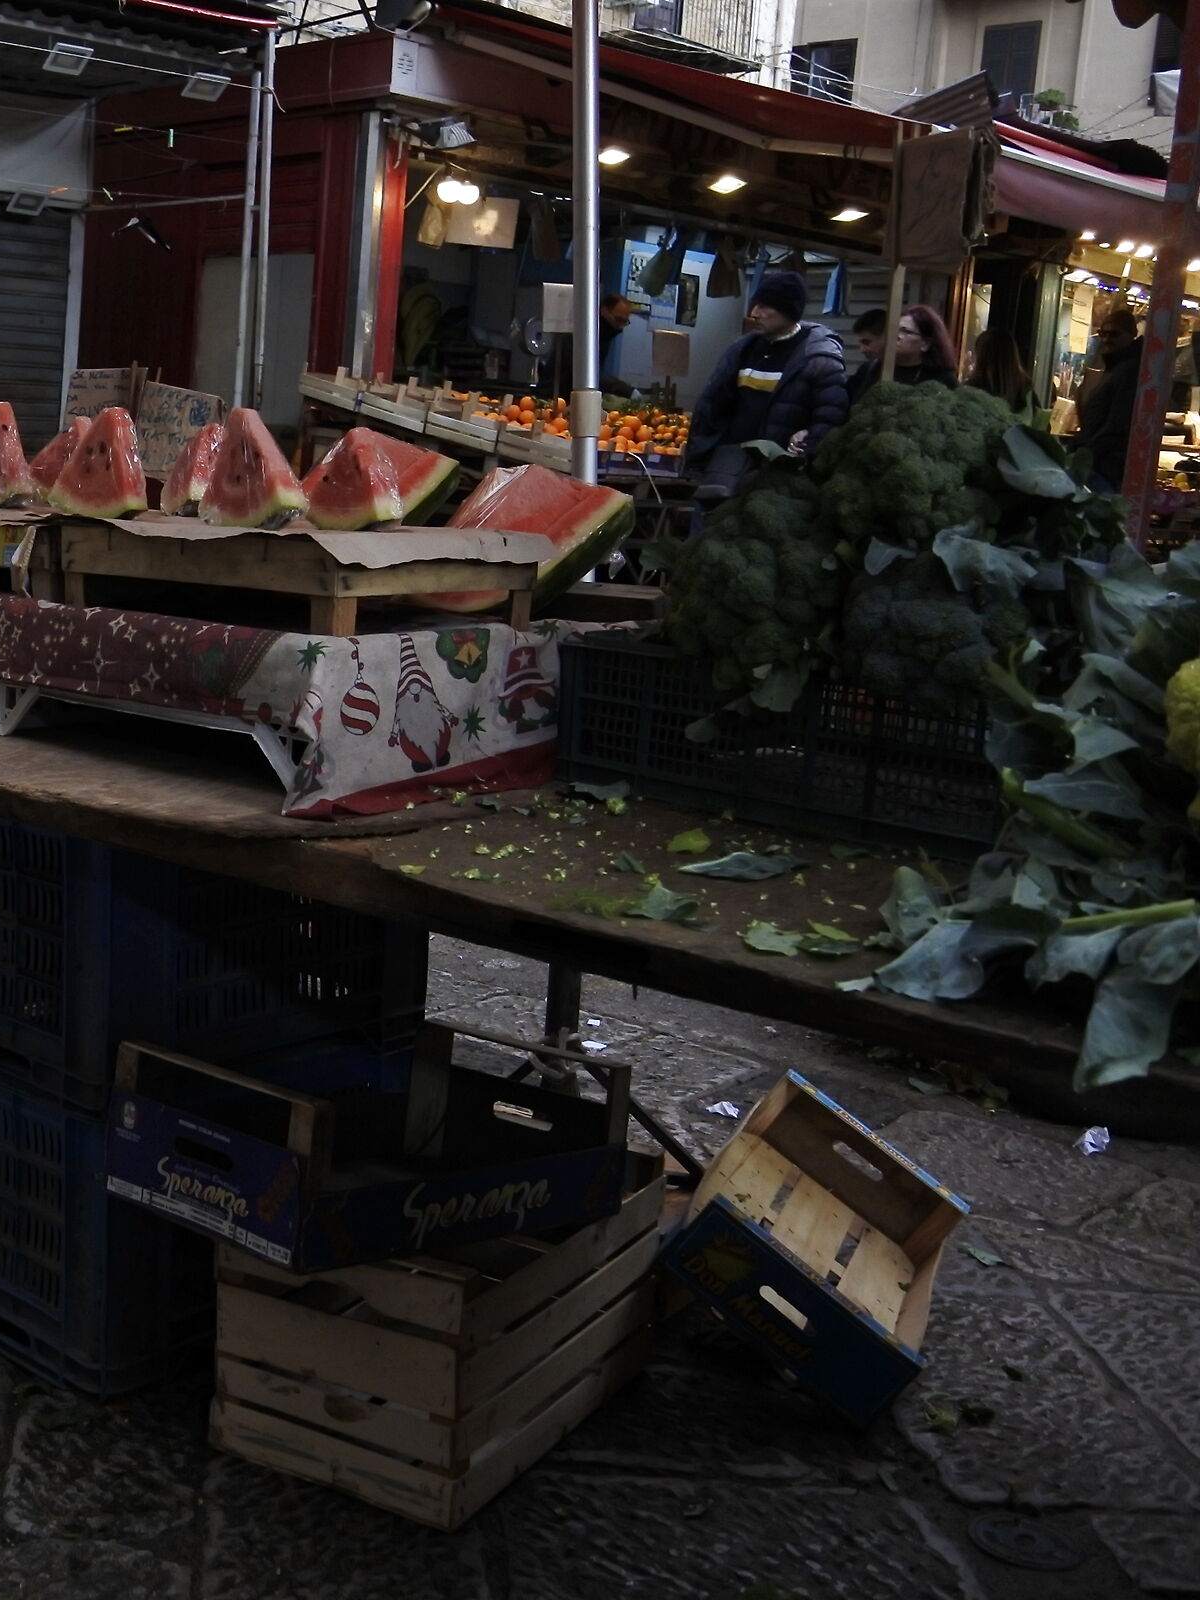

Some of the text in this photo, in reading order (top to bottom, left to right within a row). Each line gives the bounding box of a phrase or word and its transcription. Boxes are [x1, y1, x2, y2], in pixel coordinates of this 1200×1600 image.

[156, 1155, 249, 1225] Speranza
[402, 1177, 552, 1250] Speranza
[679, 1250, 730, 1298] Don
